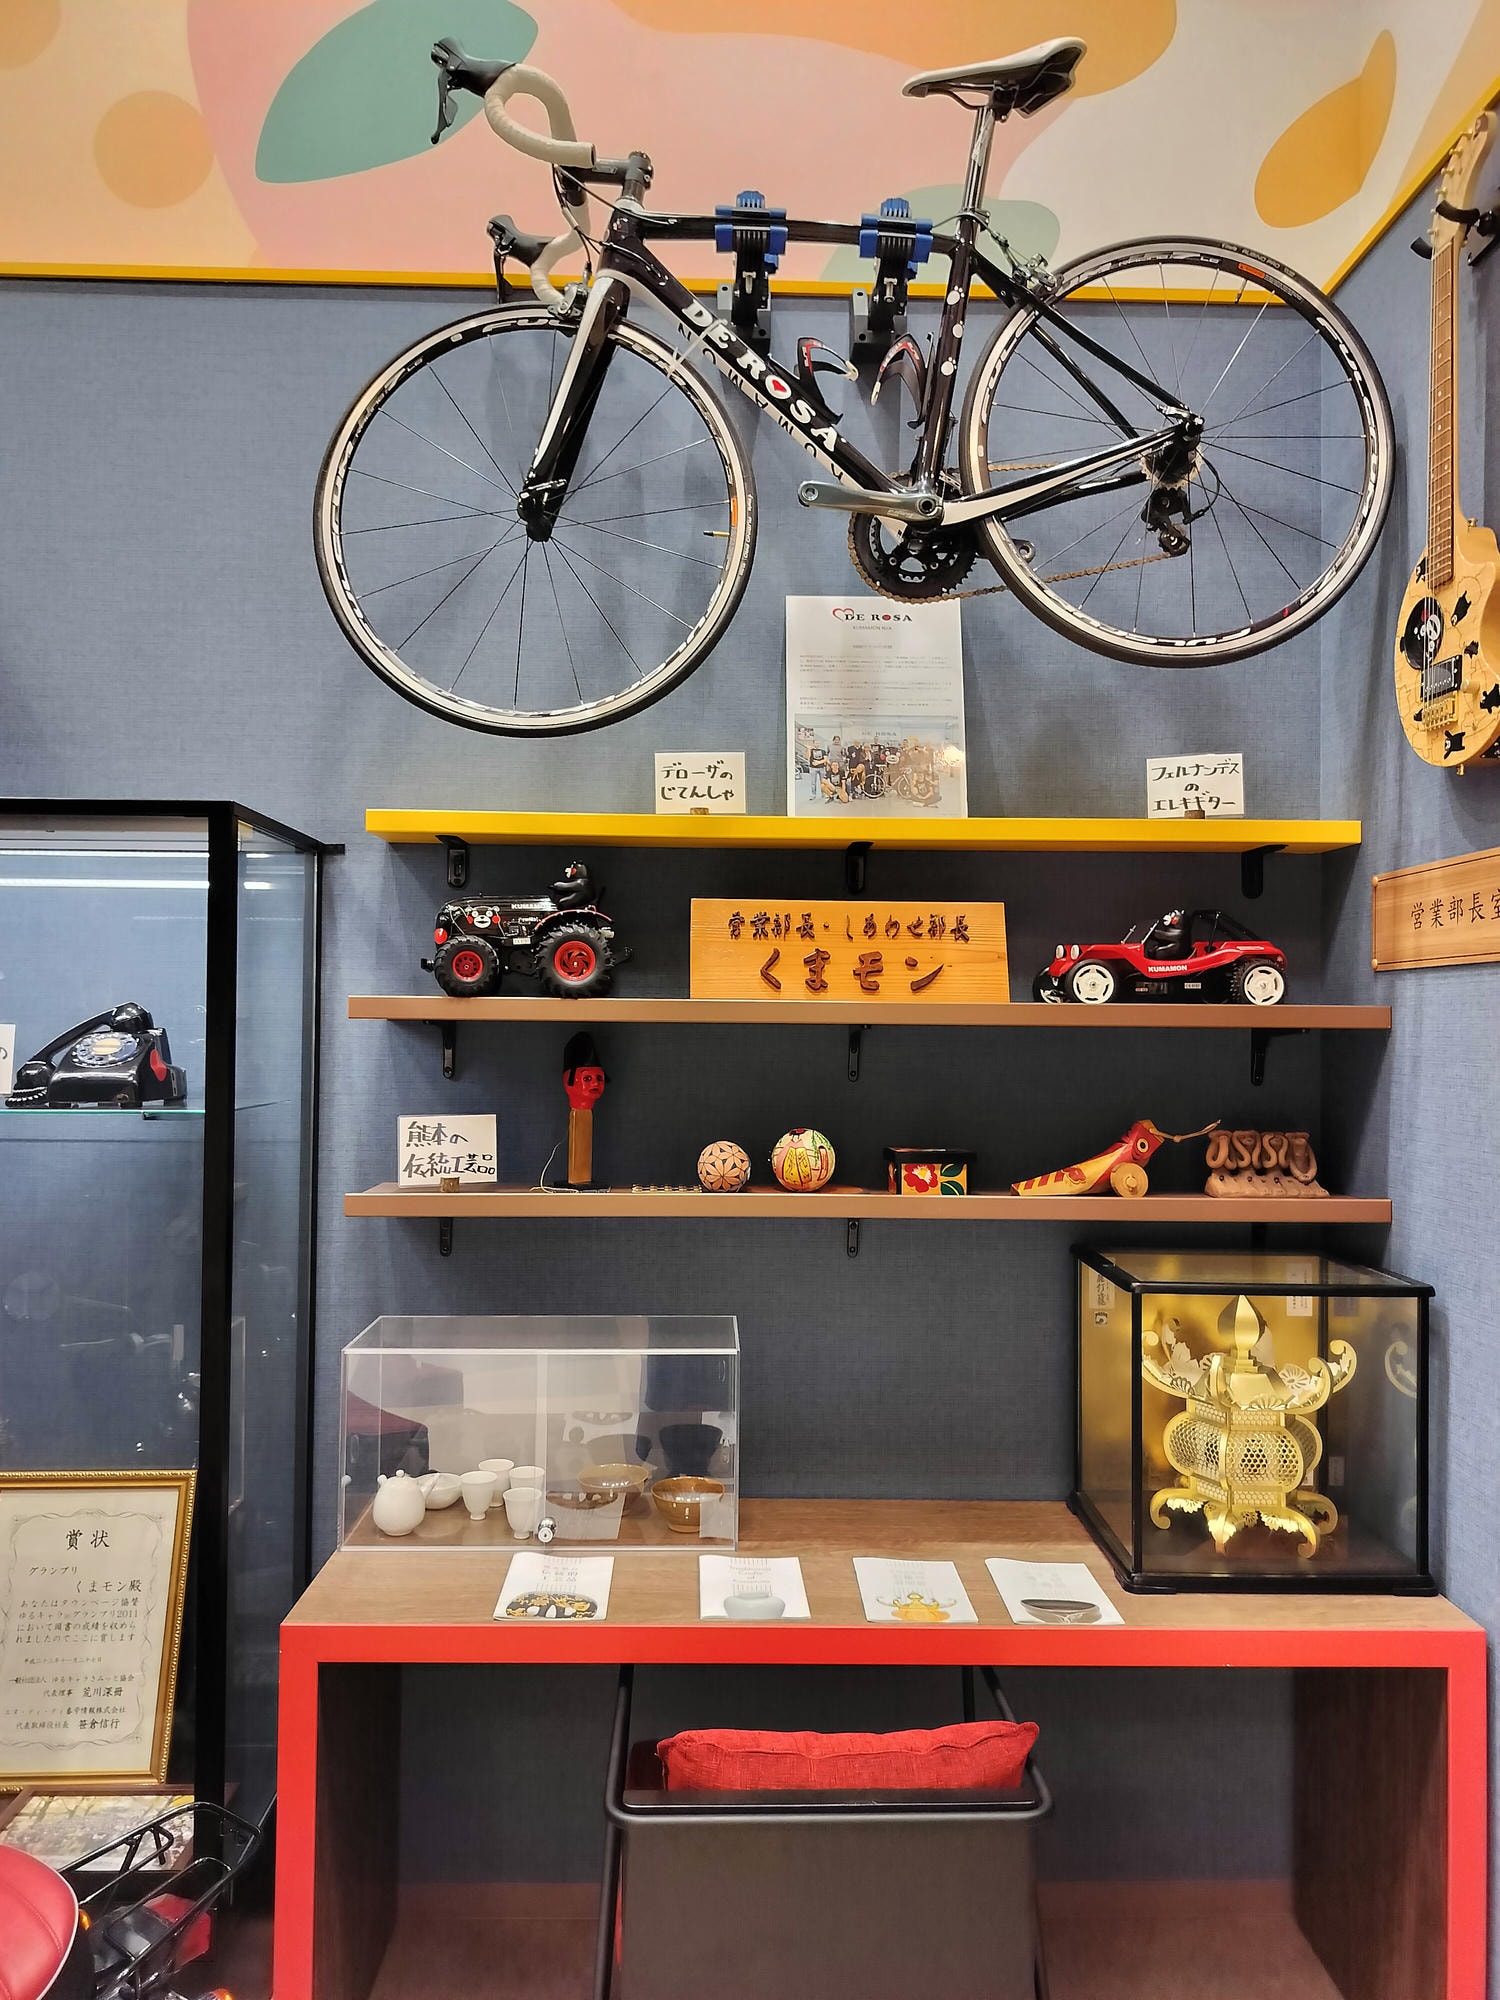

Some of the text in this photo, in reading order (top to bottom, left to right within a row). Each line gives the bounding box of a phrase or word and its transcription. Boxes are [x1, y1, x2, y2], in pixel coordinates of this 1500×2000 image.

[845, 613, 913, 622] DE ROSA
[661, 760, 733, 780] デローザの
[1152, 758, 1240, 781] フェルナンデス
[661, 786, 734, 800] じてんしゃ
[1184, 783, 1199, 791] の
[1152, 791, 1236, 811] エレキギター
[760, 948, 945, 992] くまモン
[1148, 965, 1188, 973] KUMAMON
[406, 1121, 469, 1147] 熊本の
[403, 1153, 496, 1178] 伝統工芸品
[29, 1566, 78, 1576] グランプリ
[76, 1579, 142, 1593] くまモン殿
